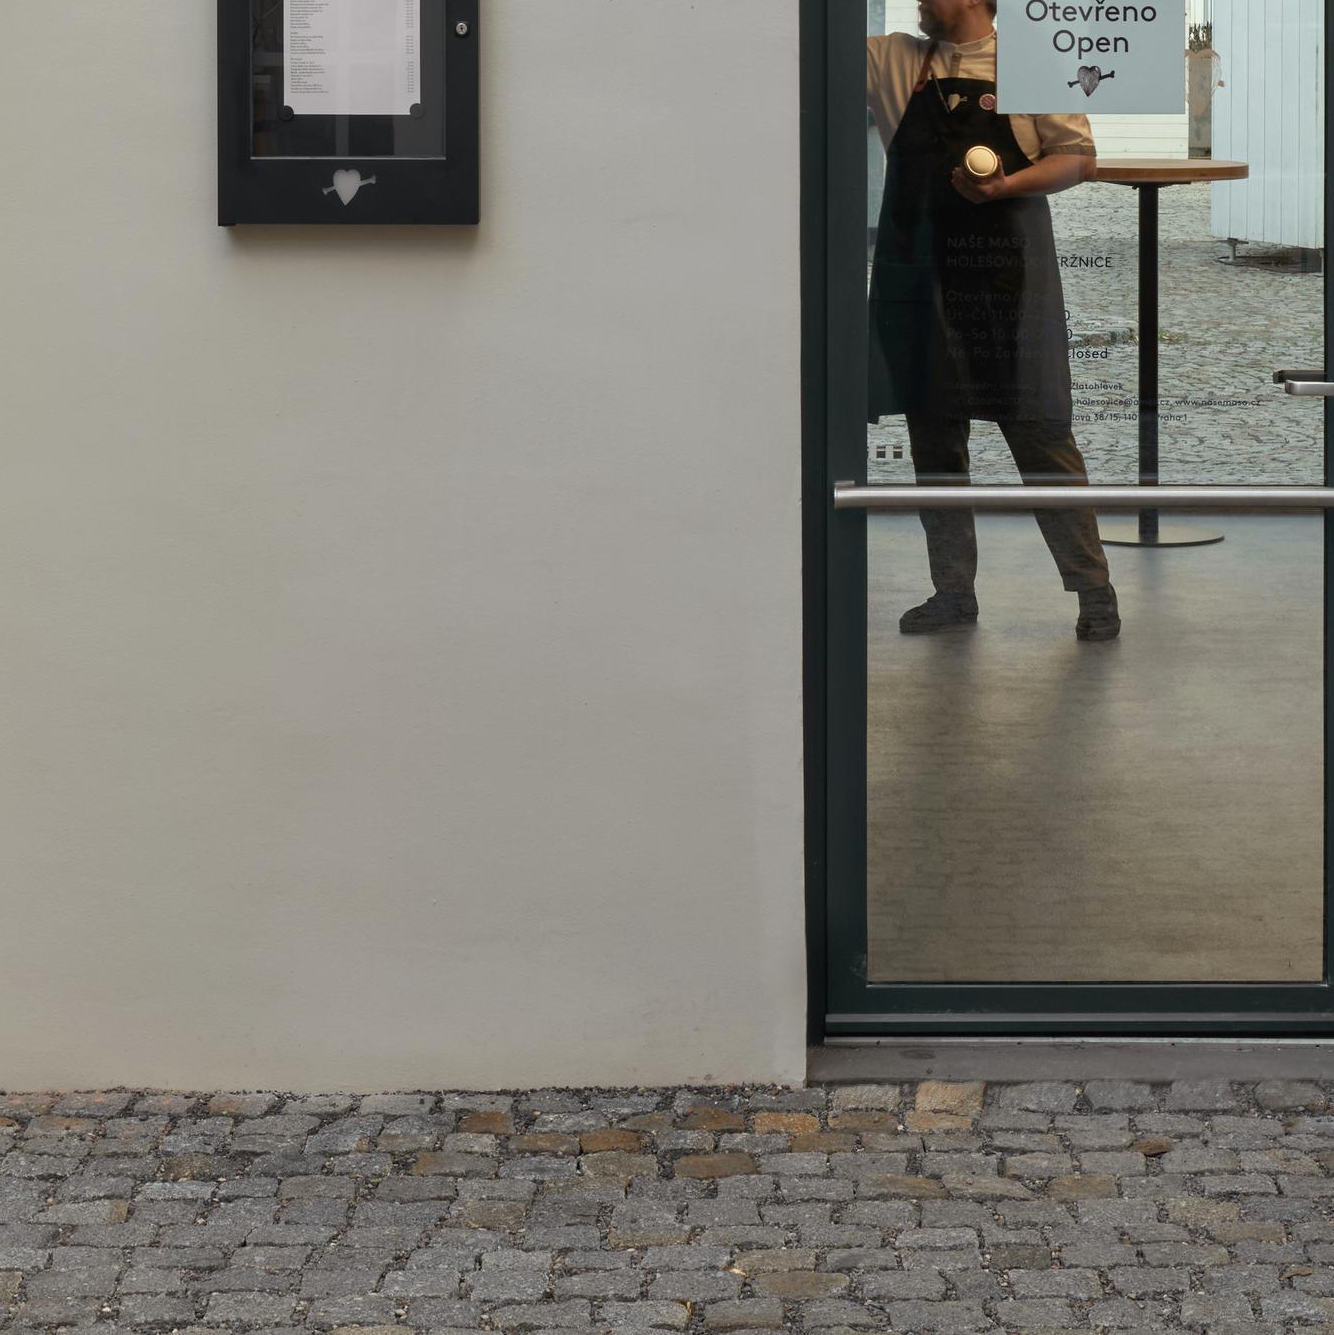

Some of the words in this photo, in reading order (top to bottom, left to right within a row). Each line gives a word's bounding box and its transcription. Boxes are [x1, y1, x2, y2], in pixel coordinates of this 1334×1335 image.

[1052, 29, 1129, 60] Open
[947, 233, 986, 249] NAŠE
[988, 236, 1031, 249] MASO
[1158, 413, 1181, 421] raha
